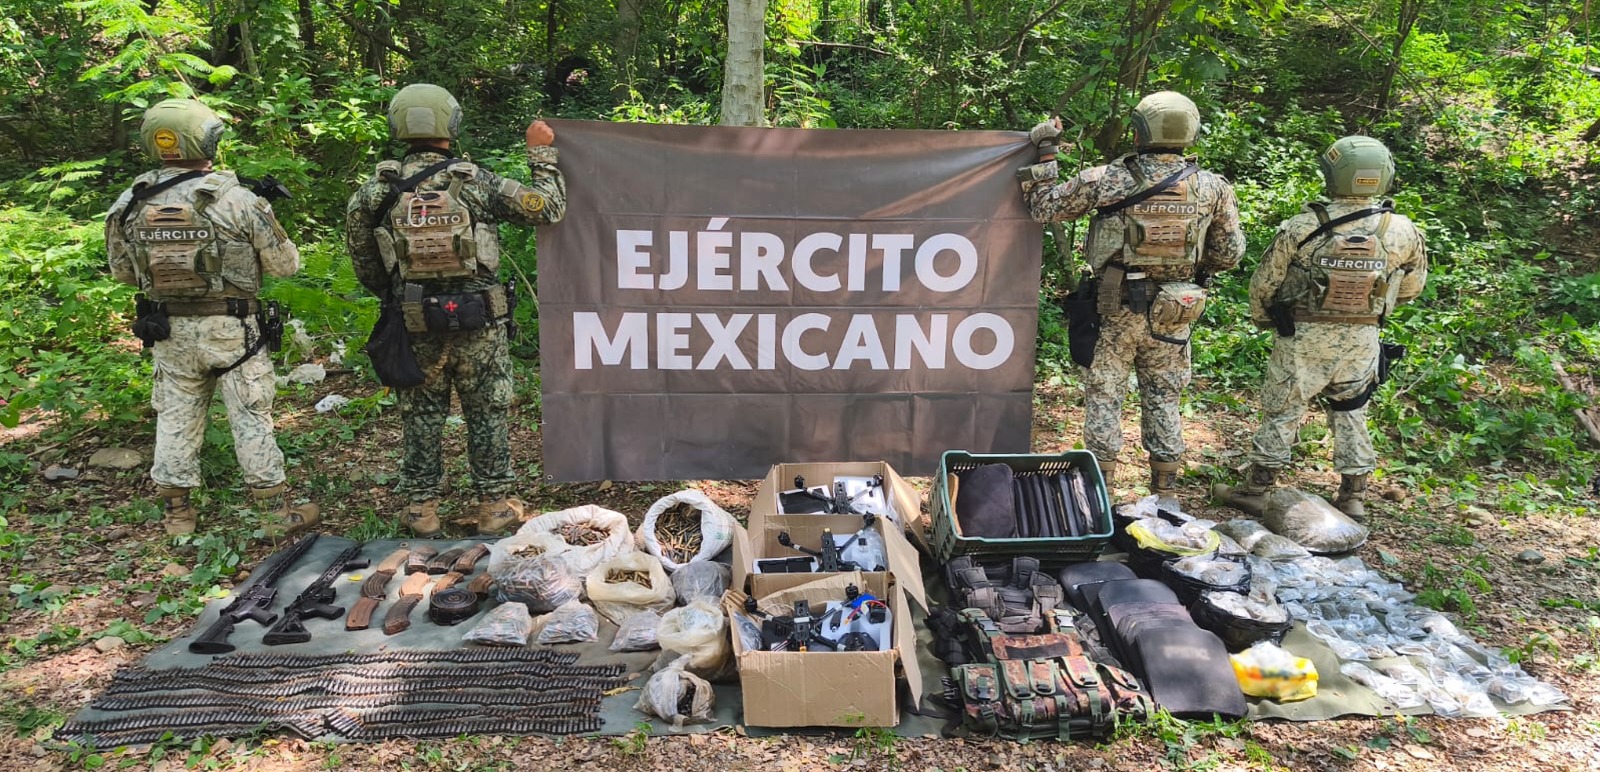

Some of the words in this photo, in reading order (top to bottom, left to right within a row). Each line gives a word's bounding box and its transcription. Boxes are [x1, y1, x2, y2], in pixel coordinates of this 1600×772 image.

[1133, 202, 1195, 214] EJÉRCITO
[139, 228, 209, 240] EJÉRCITO
[616, 217, 978, 292] EJÉRCITO
[1320, 257, 1384, 270] EJÉRCITO
[573, 311, 1015, 370] MEXICANO
